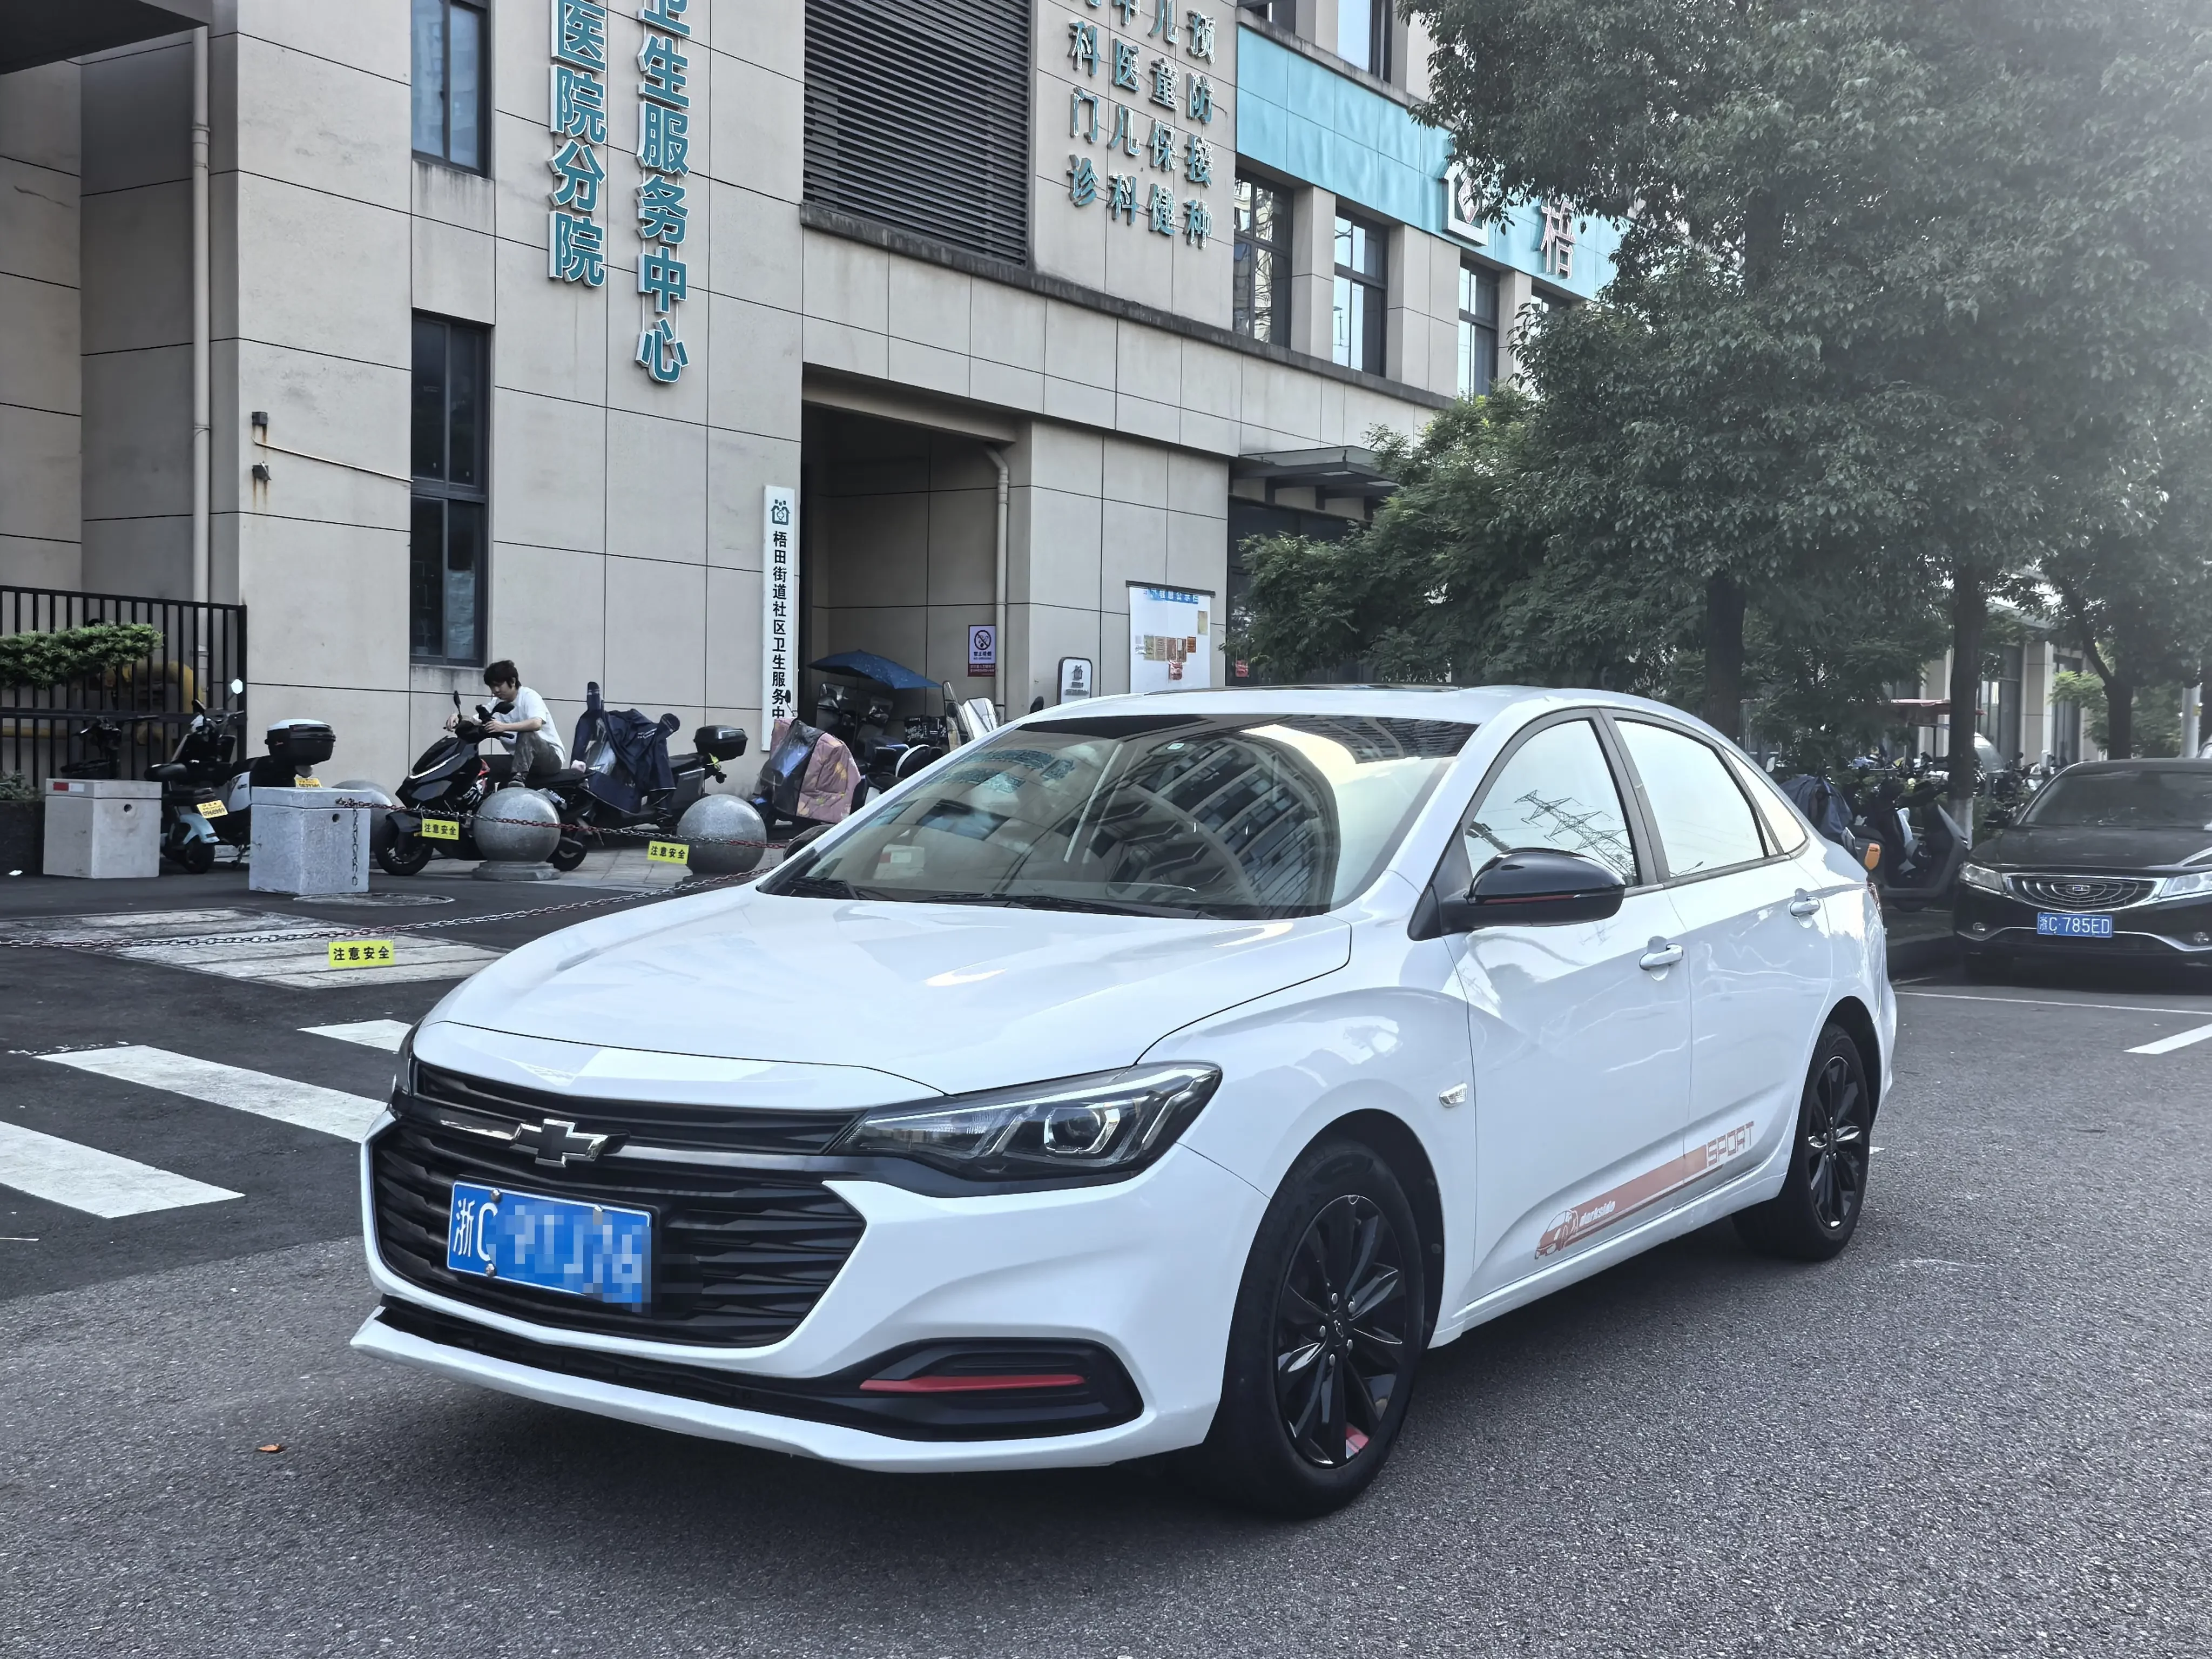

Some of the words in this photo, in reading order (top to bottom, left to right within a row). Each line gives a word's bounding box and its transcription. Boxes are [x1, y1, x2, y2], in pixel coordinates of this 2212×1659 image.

[549, 0, 606, 287] 医院分院
[1067, 0, 1101, 207] 科门诊
[1147, 0, 1179, 236] 儿童保健
[1183, 10, 1216, 249] 预防接种
[771, 531, 787, 718] 梧田街道社区卫生服务中
[424, 823, 456, 835] 注意安全
[650, 846, 685, 859] 注意安全
[333, 946, 389, 961] 注意安全
[1708, 1121, 1754, 1166] SPORT
